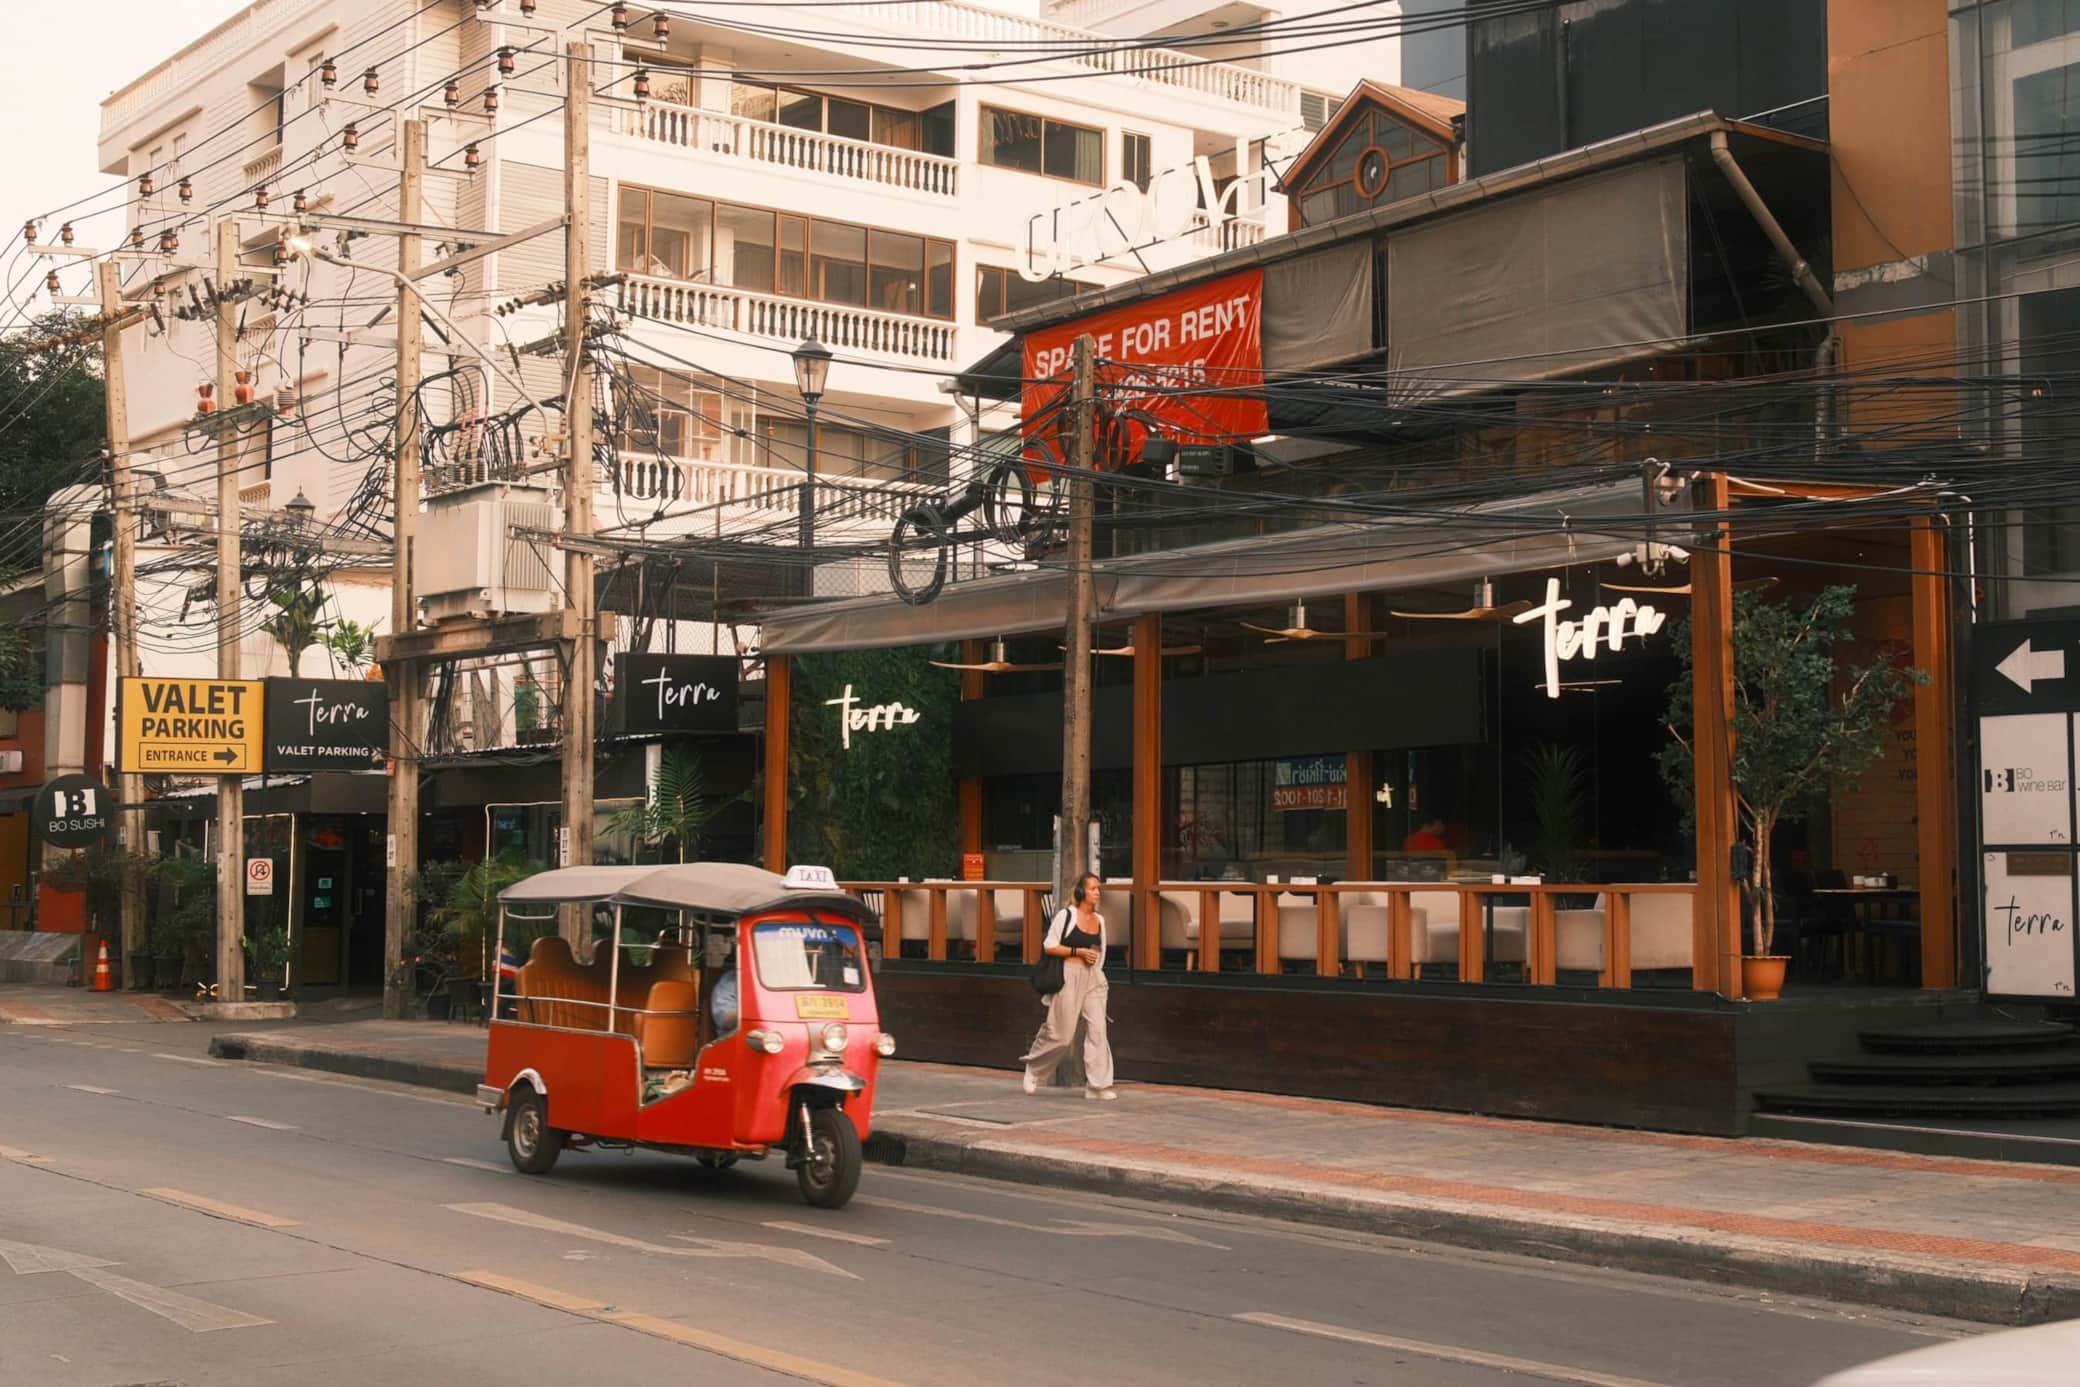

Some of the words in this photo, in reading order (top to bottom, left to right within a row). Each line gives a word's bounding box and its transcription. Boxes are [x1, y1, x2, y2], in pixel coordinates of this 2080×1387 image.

[1035, 332, 1113, 379] SPAE
[1121, 318, 1170, 359] FOR
[1180, 294, 1250, 344] RENT
[1512, 577, 1667, 698] terra
[141, 683, 247, 715] VALET
[640, 666, 721, 720] terra
[293, 687, 369, 736] terra
[825, 684, 921, 750] terra
[141, 717, 245, 739] PARKING
[145, 750, 208, 762] ENTRANCE
[277, 745, 315, 756] VALET
[318, 746, 369, 757] PARKING
[2016, 768, 2032, 780] BO
[48, 820, 68, 833] BO
[70, 818, 105, 831] SUSHI
[799, 869, 828, 883] TAXI
[1993, 895, 2065, 946] terra
